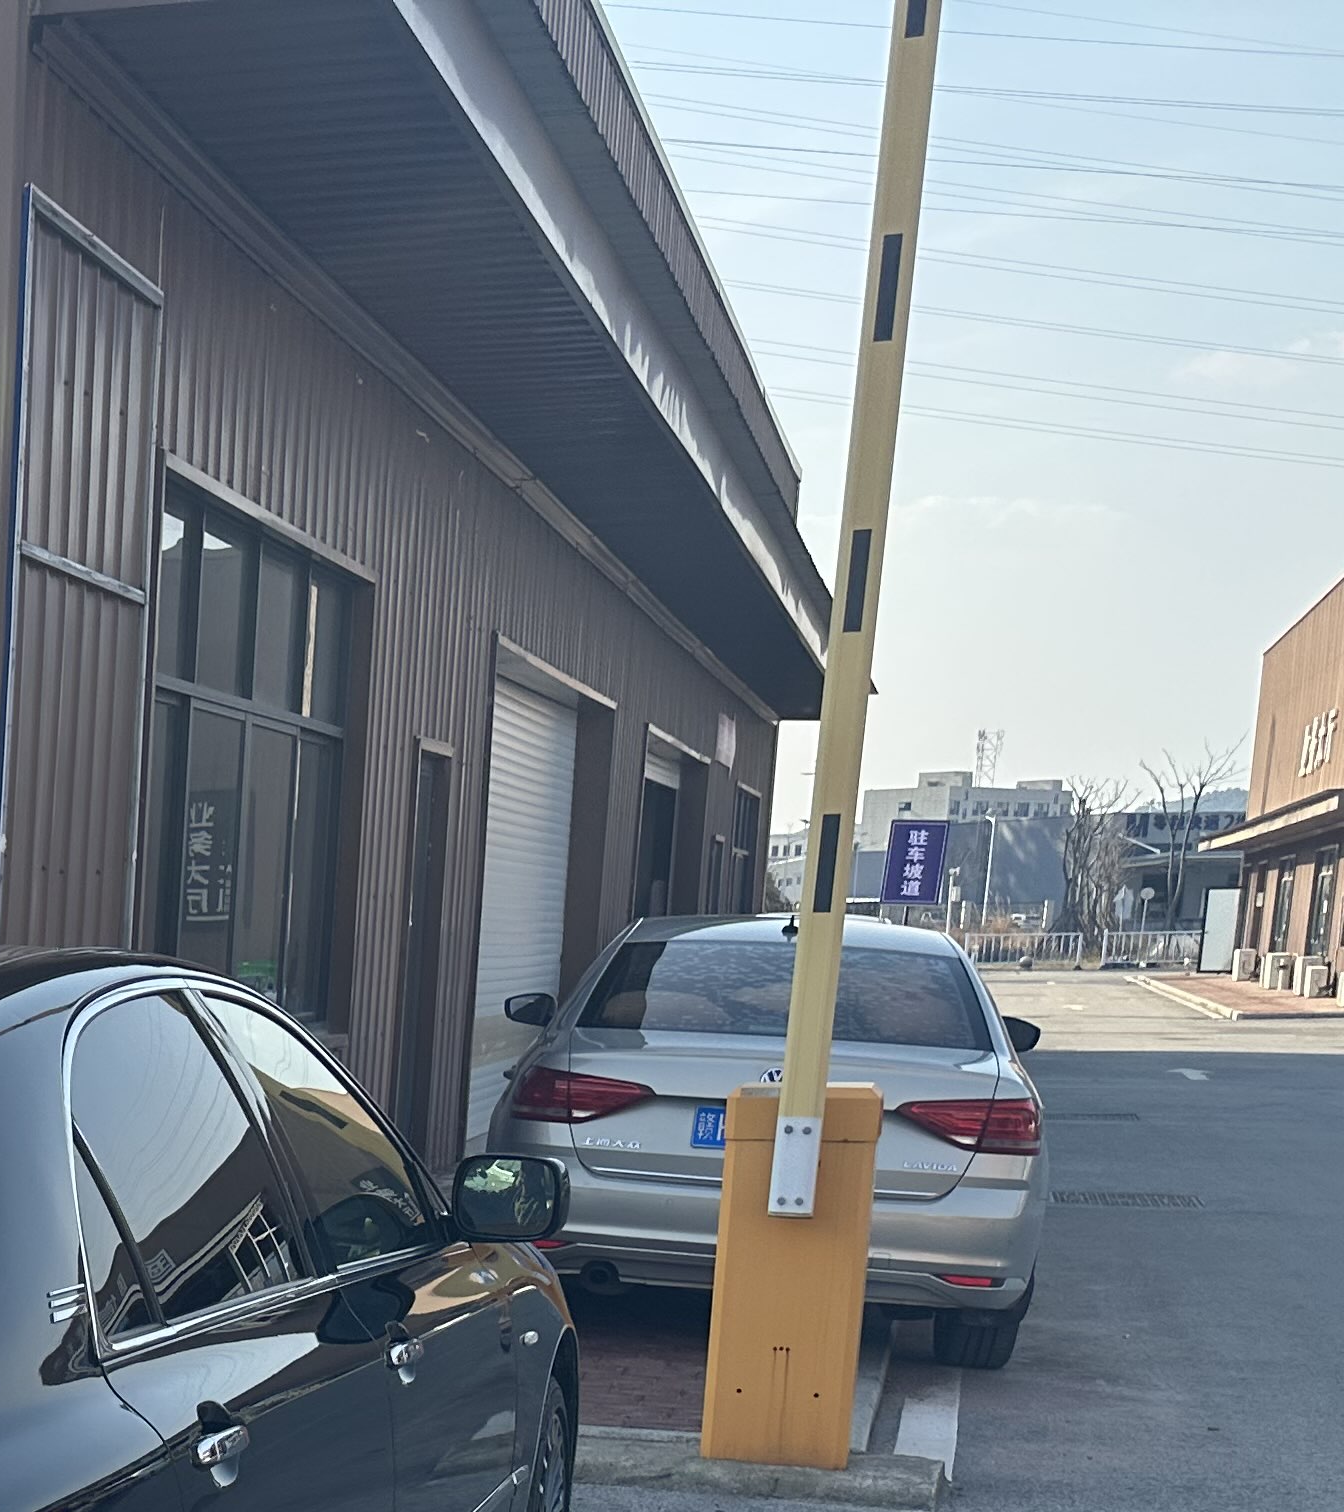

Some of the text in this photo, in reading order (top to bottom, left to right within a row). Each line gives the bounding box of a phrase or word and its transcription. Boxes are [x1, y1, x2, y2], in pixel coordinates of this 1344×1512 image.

[900, 829, 930, 896] 驻车坡道
[903, 1161, 957, 1171] LAVIDA
